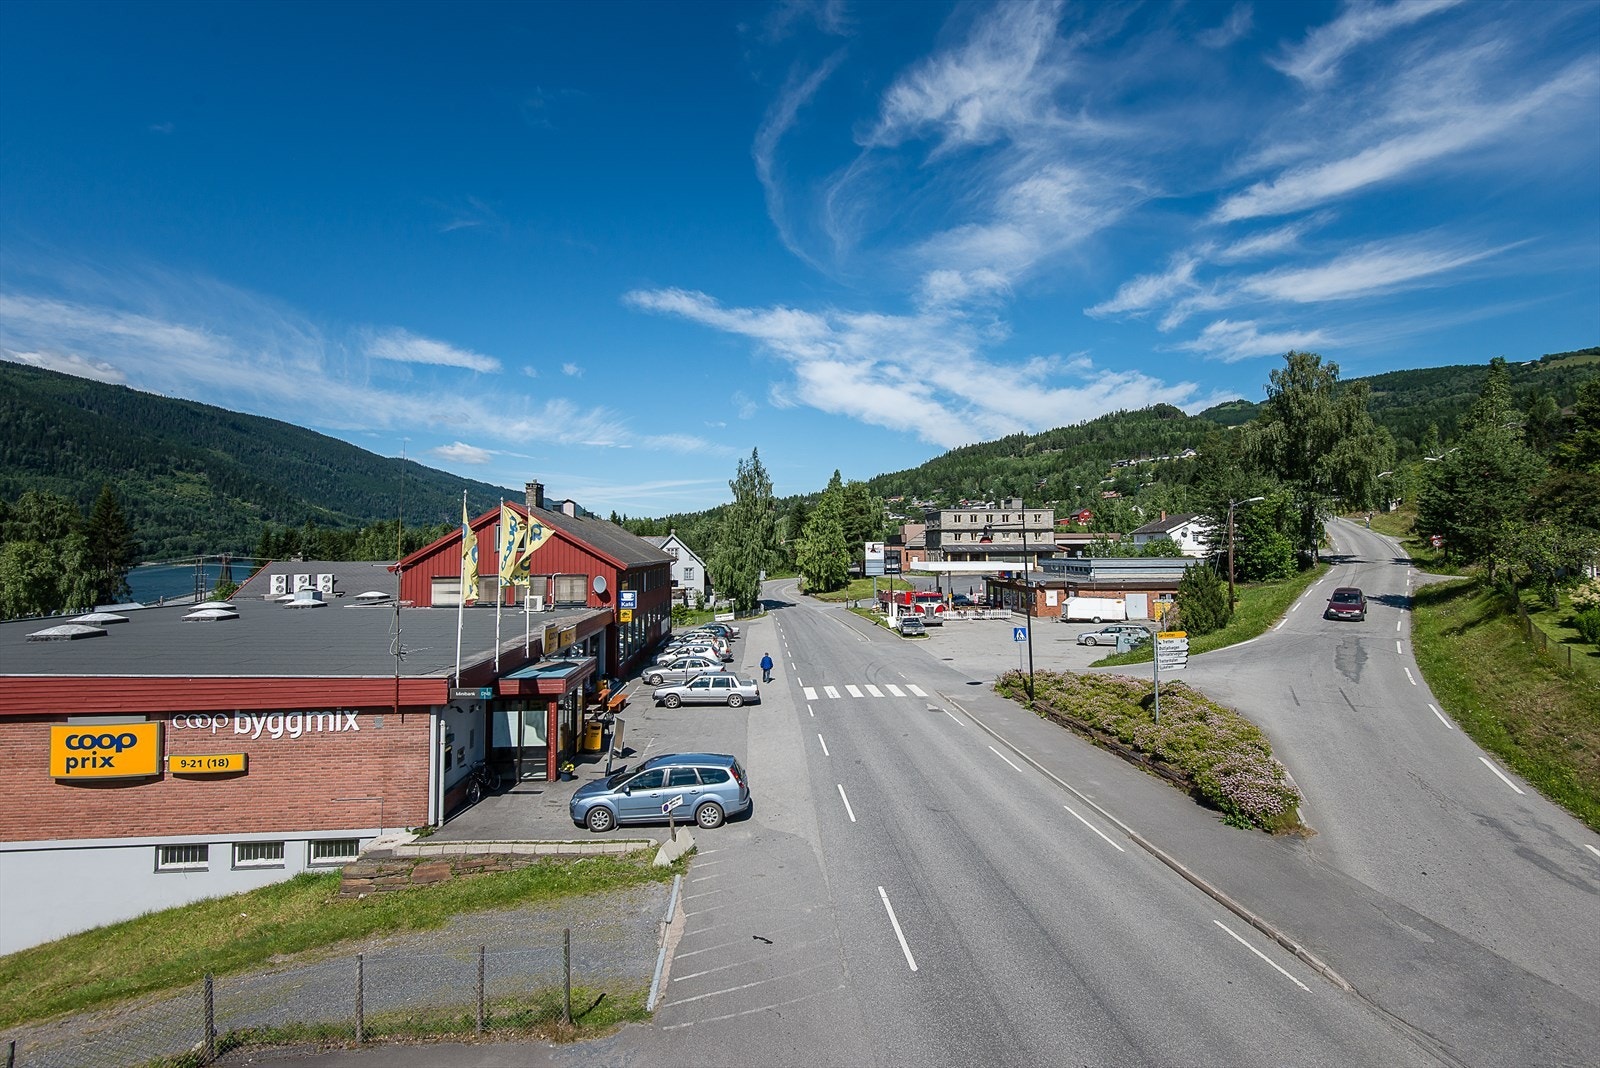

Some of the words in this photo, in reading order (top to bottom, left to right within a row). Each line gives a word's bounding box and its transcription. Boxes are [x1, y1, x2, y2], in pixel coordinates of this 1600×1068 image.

[172, 713, 229, 735] coop
[233, 707, 360, 740] byggmix
[65, 733, 138, 753] coop
[65, 751, 115, 774] prix
[180, 758, 203, 768] 9-21
[206, 757, 230, 769] (18)
